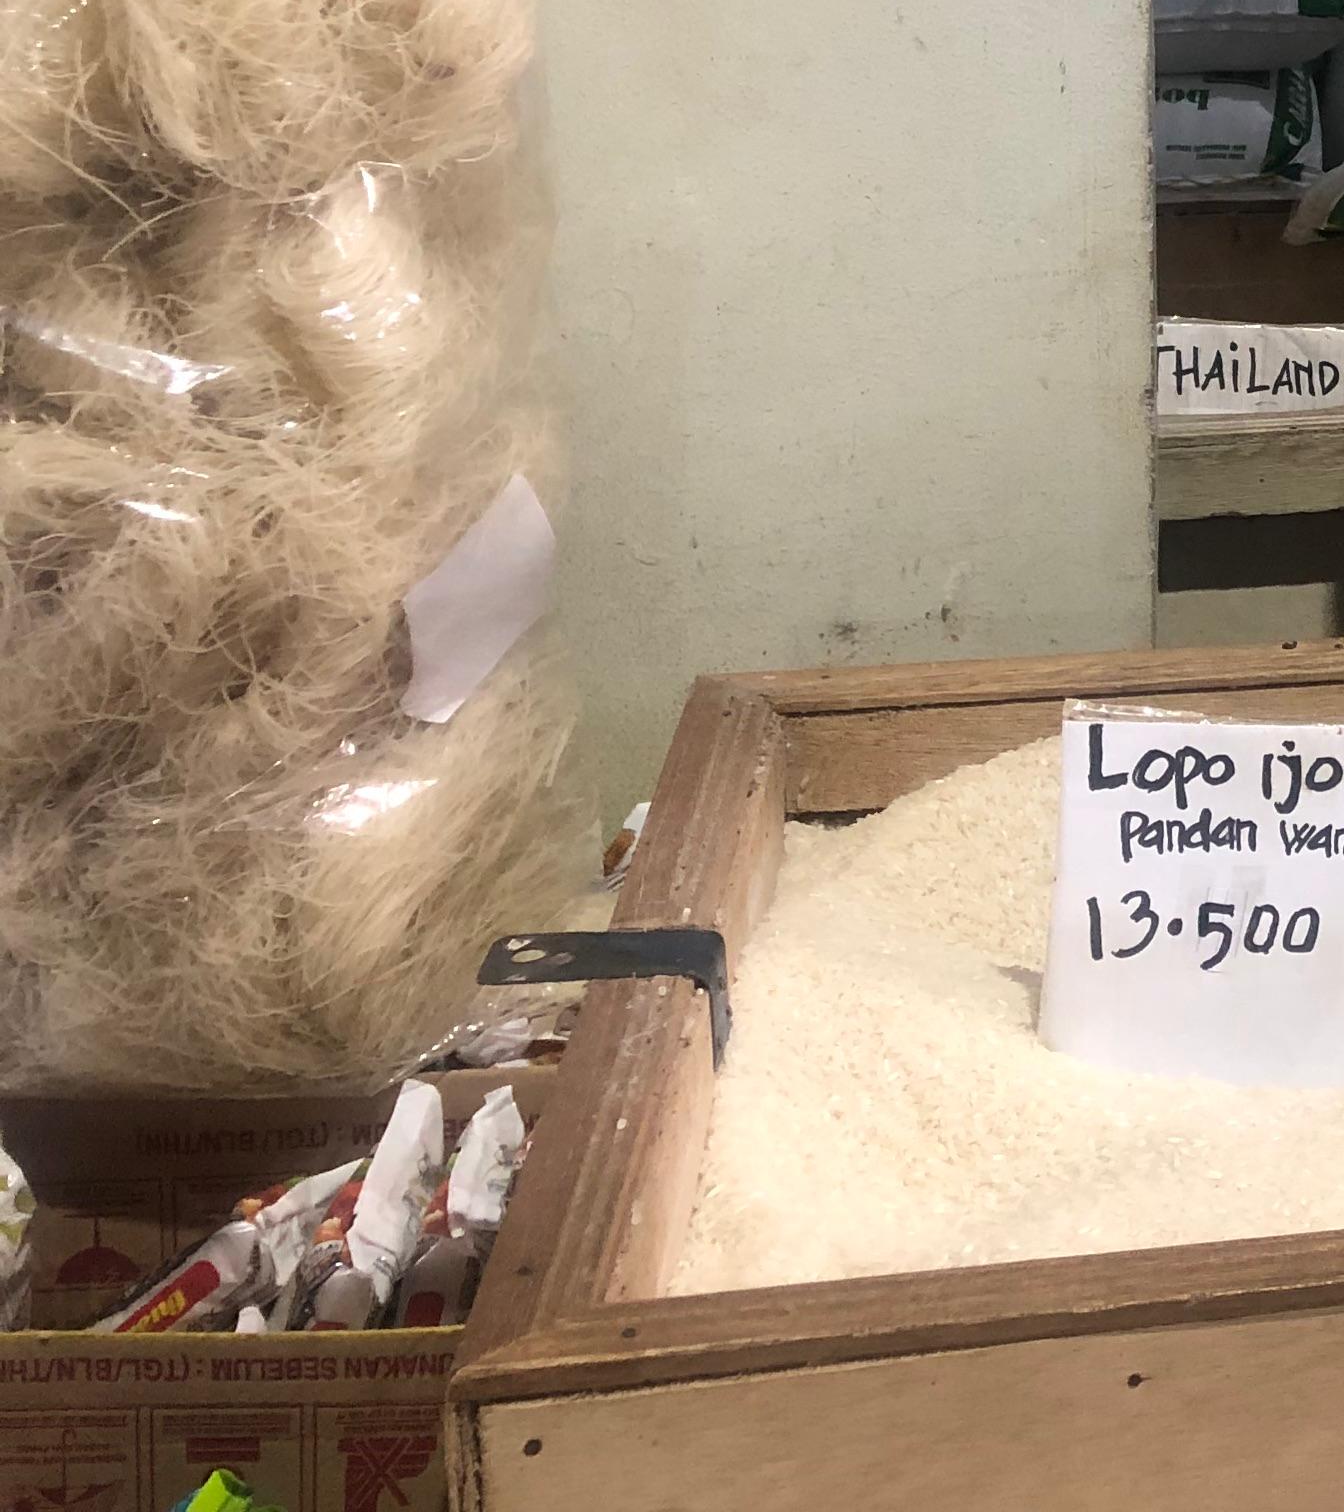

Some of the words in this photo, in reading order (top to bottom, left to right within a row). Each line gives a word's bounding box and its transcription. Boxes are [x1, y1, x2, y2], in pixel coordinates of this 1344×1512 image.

[1088, 724, 1235, 809] Lopo
[1087, 890, 1320, 970] 13.500
[211, 1358, 337, 1382] SEBELUM
